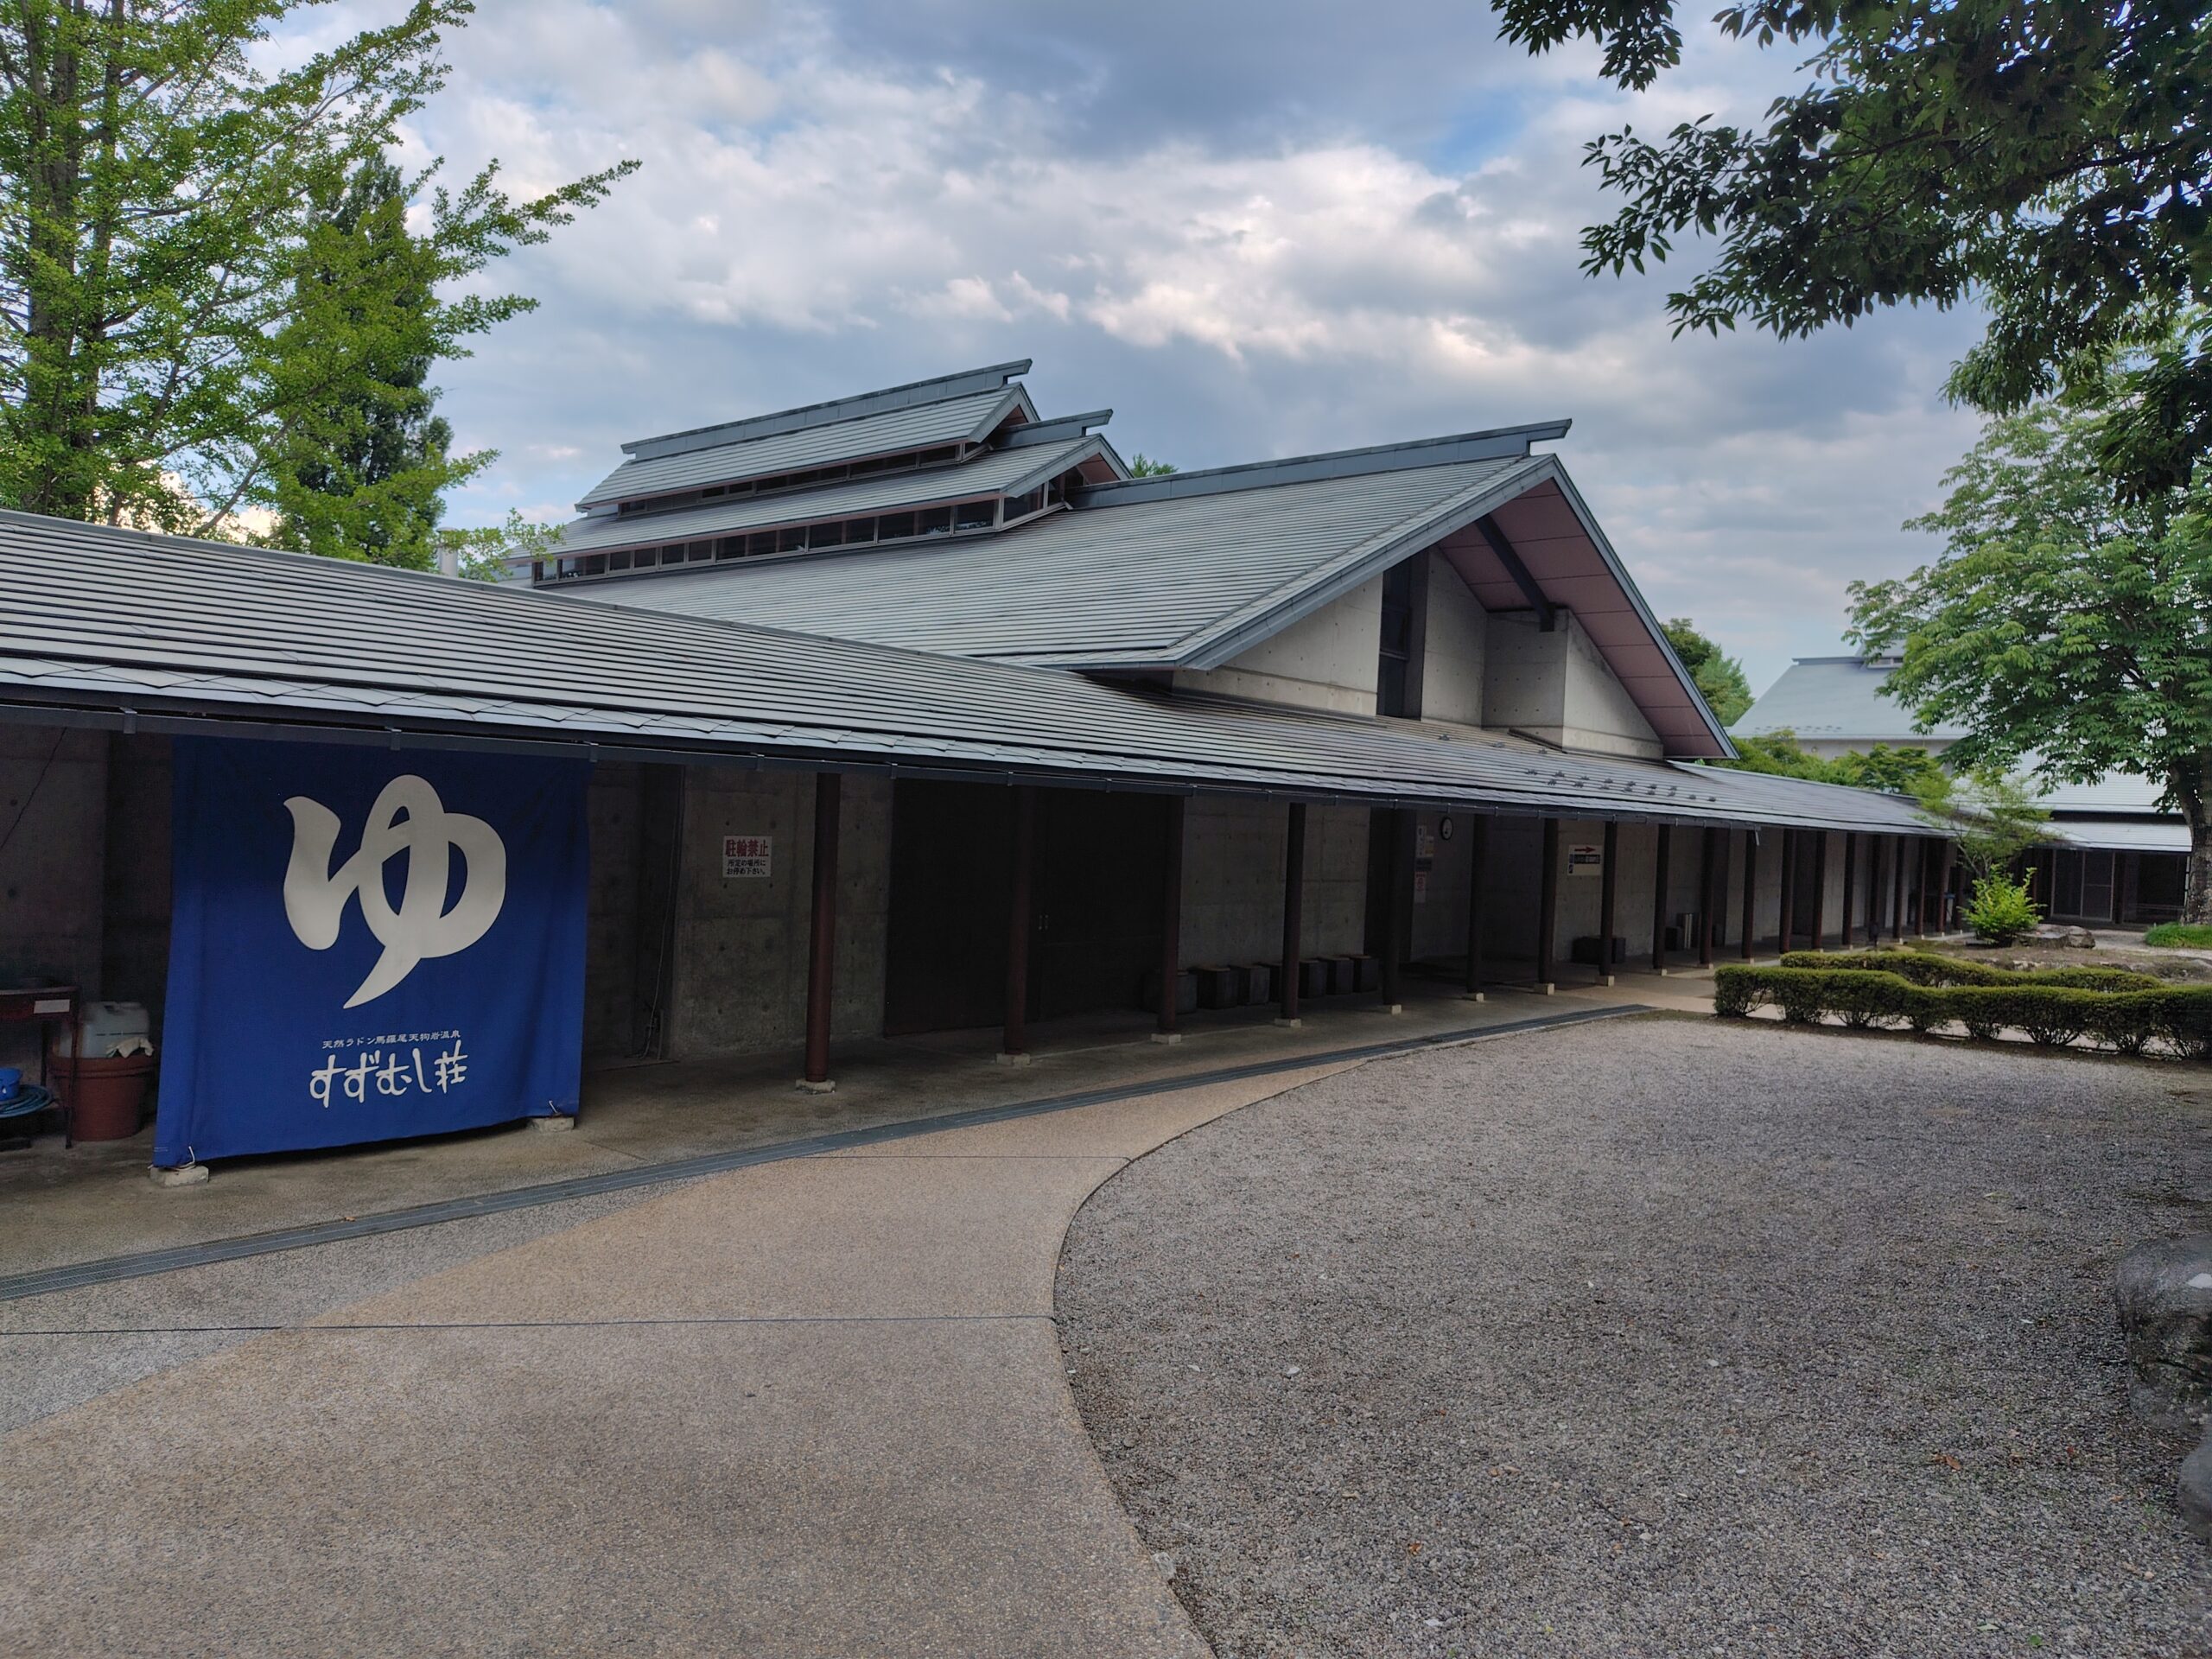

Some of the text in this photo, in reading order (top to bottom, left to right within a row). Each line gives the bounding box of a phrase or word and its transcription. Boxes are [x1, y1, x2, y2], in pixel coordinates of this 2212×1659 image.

[725, 839, 769, 857] 駐輪禁止
[284, 774, 506, 1009] ゆ
[309, 1039, 468, 1109] すずむし荘
